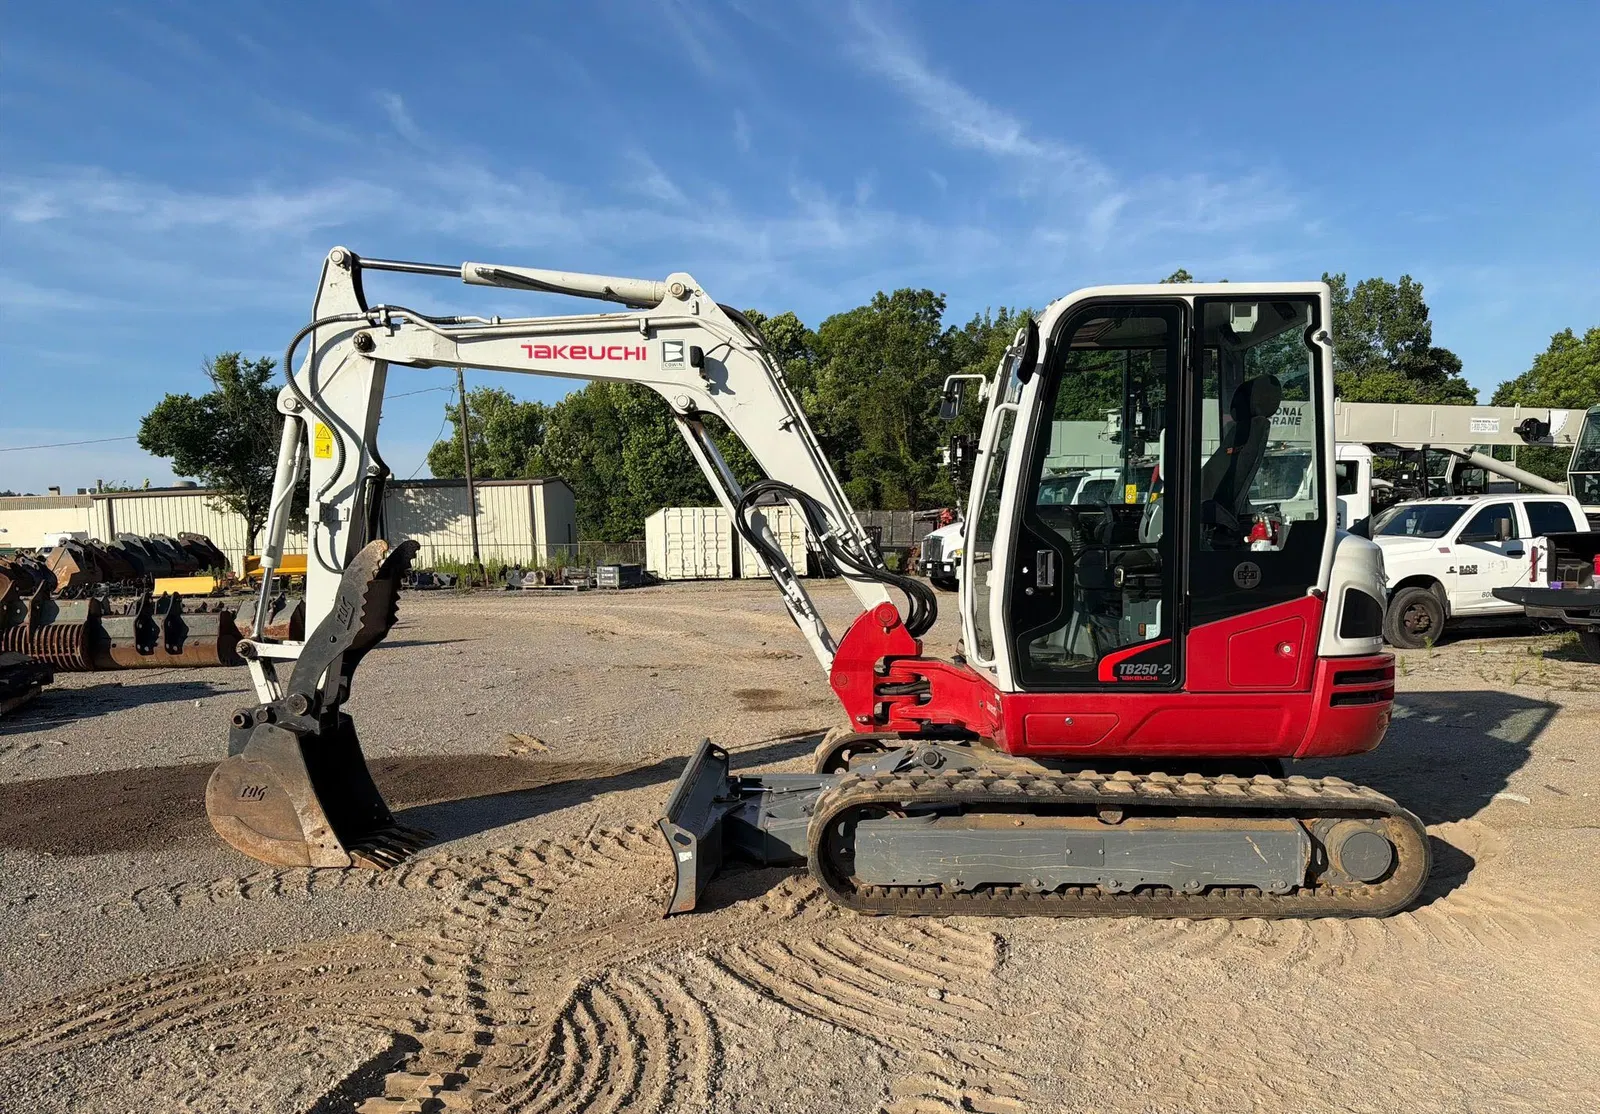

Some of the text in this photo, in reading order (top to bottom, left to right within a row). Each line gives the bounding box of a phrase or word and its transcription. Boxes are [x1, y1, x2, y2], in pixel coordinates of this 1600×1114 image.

[520, 344, 647, 361] TAKEUCHI
[1275, 406, 1302, 416] ONAL
[1269, 416, 1302, 425] RANE
[1120, 664, 1171, 675] TB250-2
